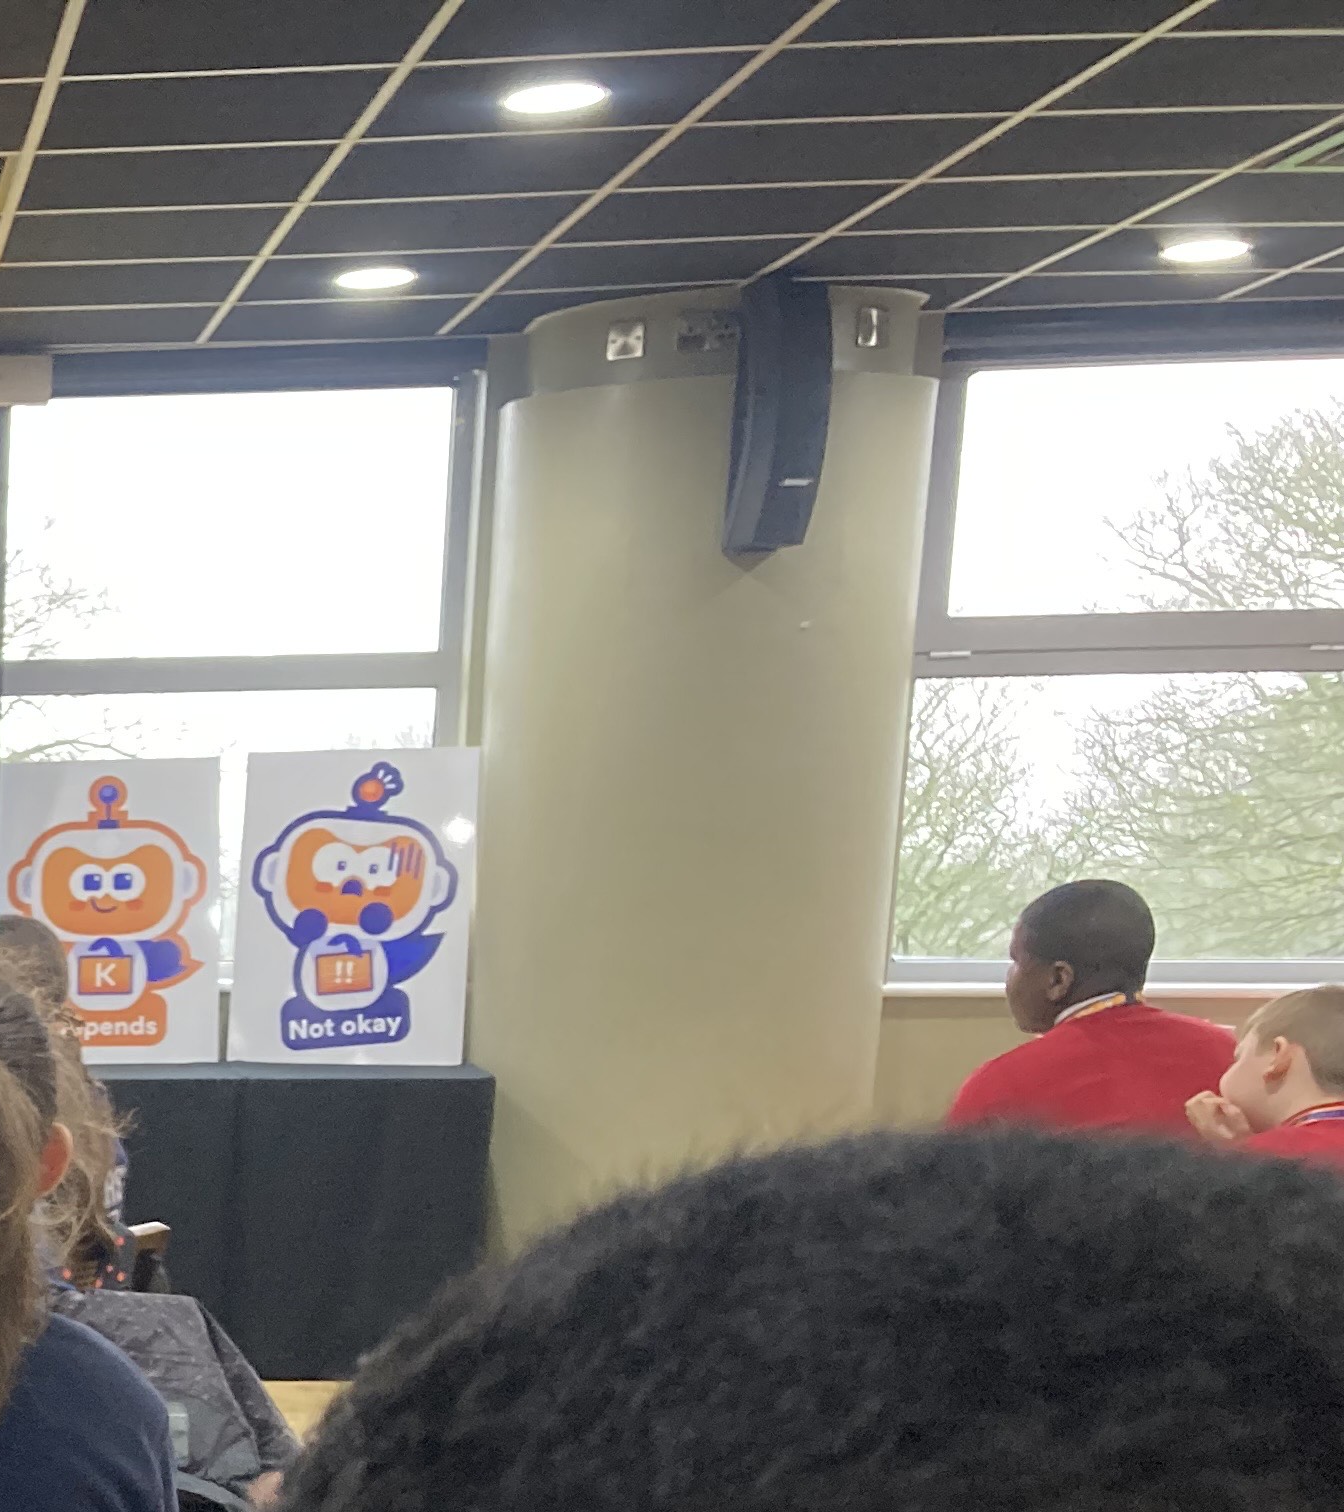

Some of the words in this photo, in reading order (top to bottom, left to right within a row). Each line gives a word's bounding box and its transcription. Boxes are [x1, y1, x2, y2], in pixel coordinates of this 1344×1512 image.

[95, 962, 117, 988] K
[76, 1016, 158, 1040] pends
[288, 1018, 335, 1040] Not
[340, 1013, 403, 1037] okay
